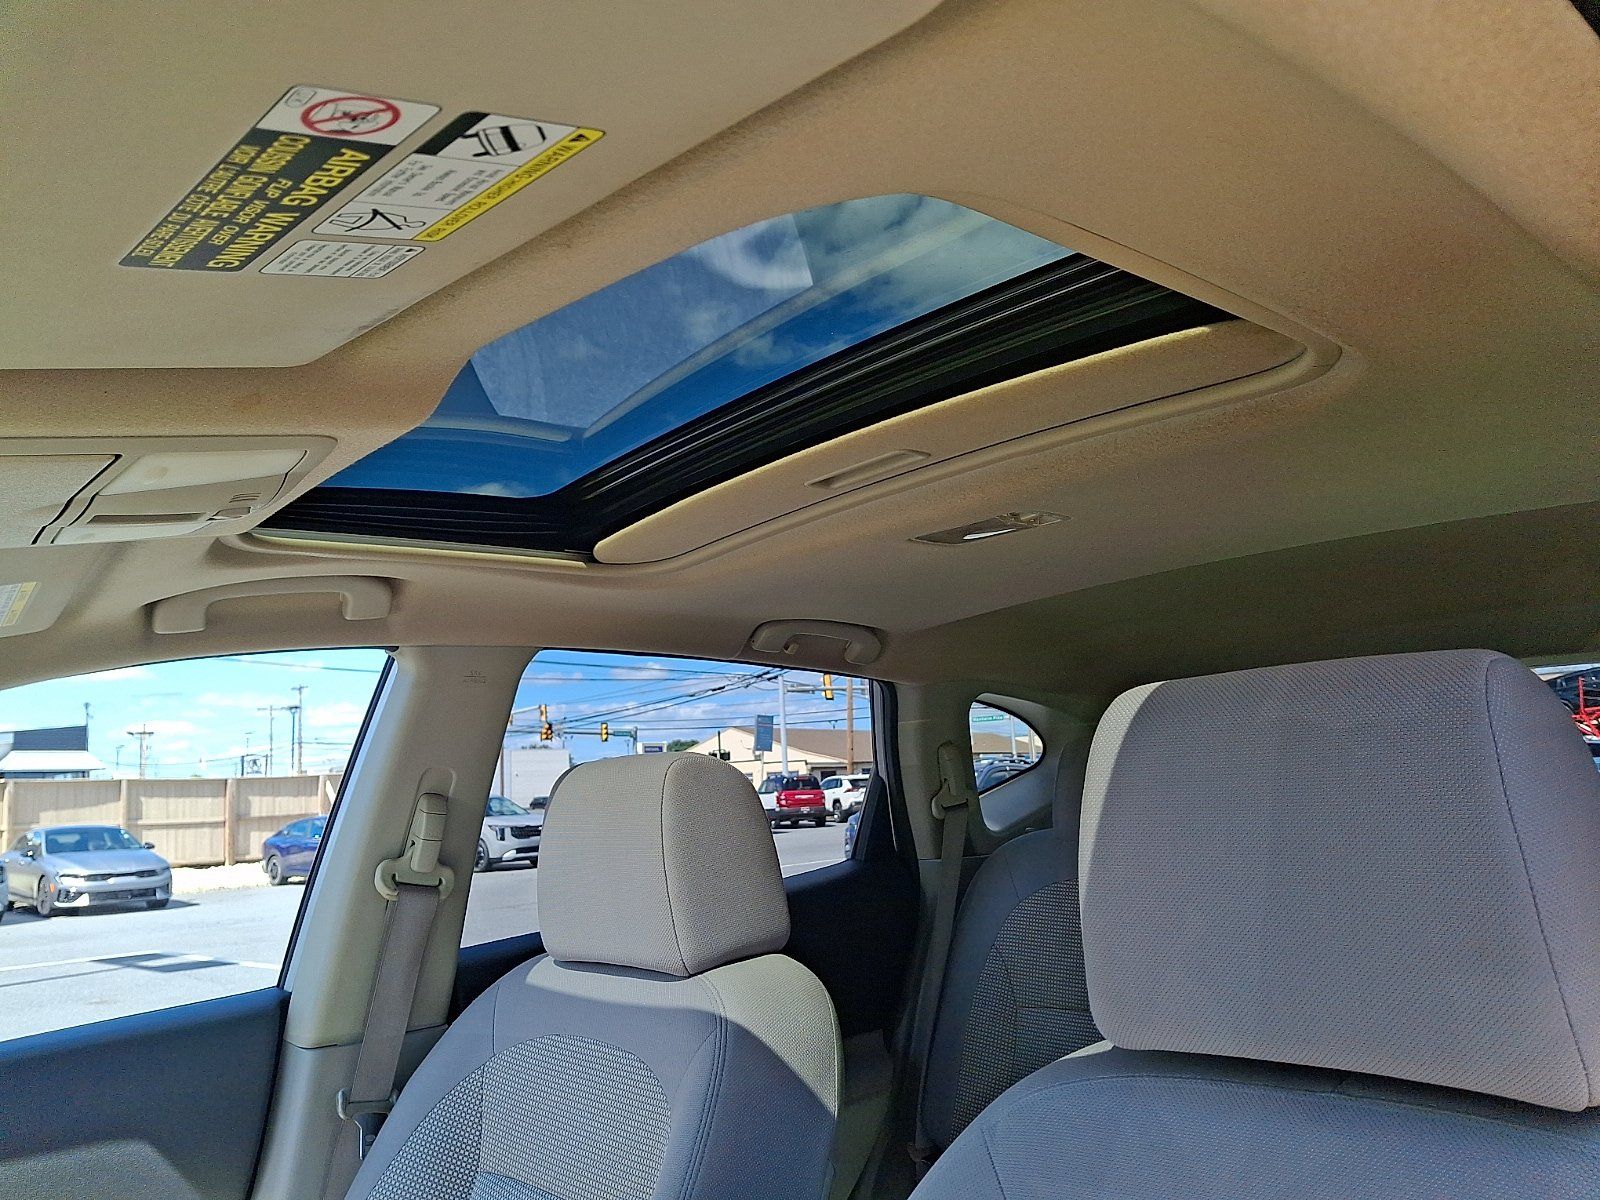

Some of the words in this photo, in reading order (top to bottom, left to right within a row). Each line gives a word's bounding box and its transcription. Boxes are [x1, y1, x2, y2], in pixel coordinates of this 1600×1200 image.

[257, 178, 295, 198] FLIP
[278, 148, 373, 206] AIRBAG
[229, 199, 271, 223] VISOR
[204, 210, 299, 268] WARNING
[205, 225, 242, 245] OVER
